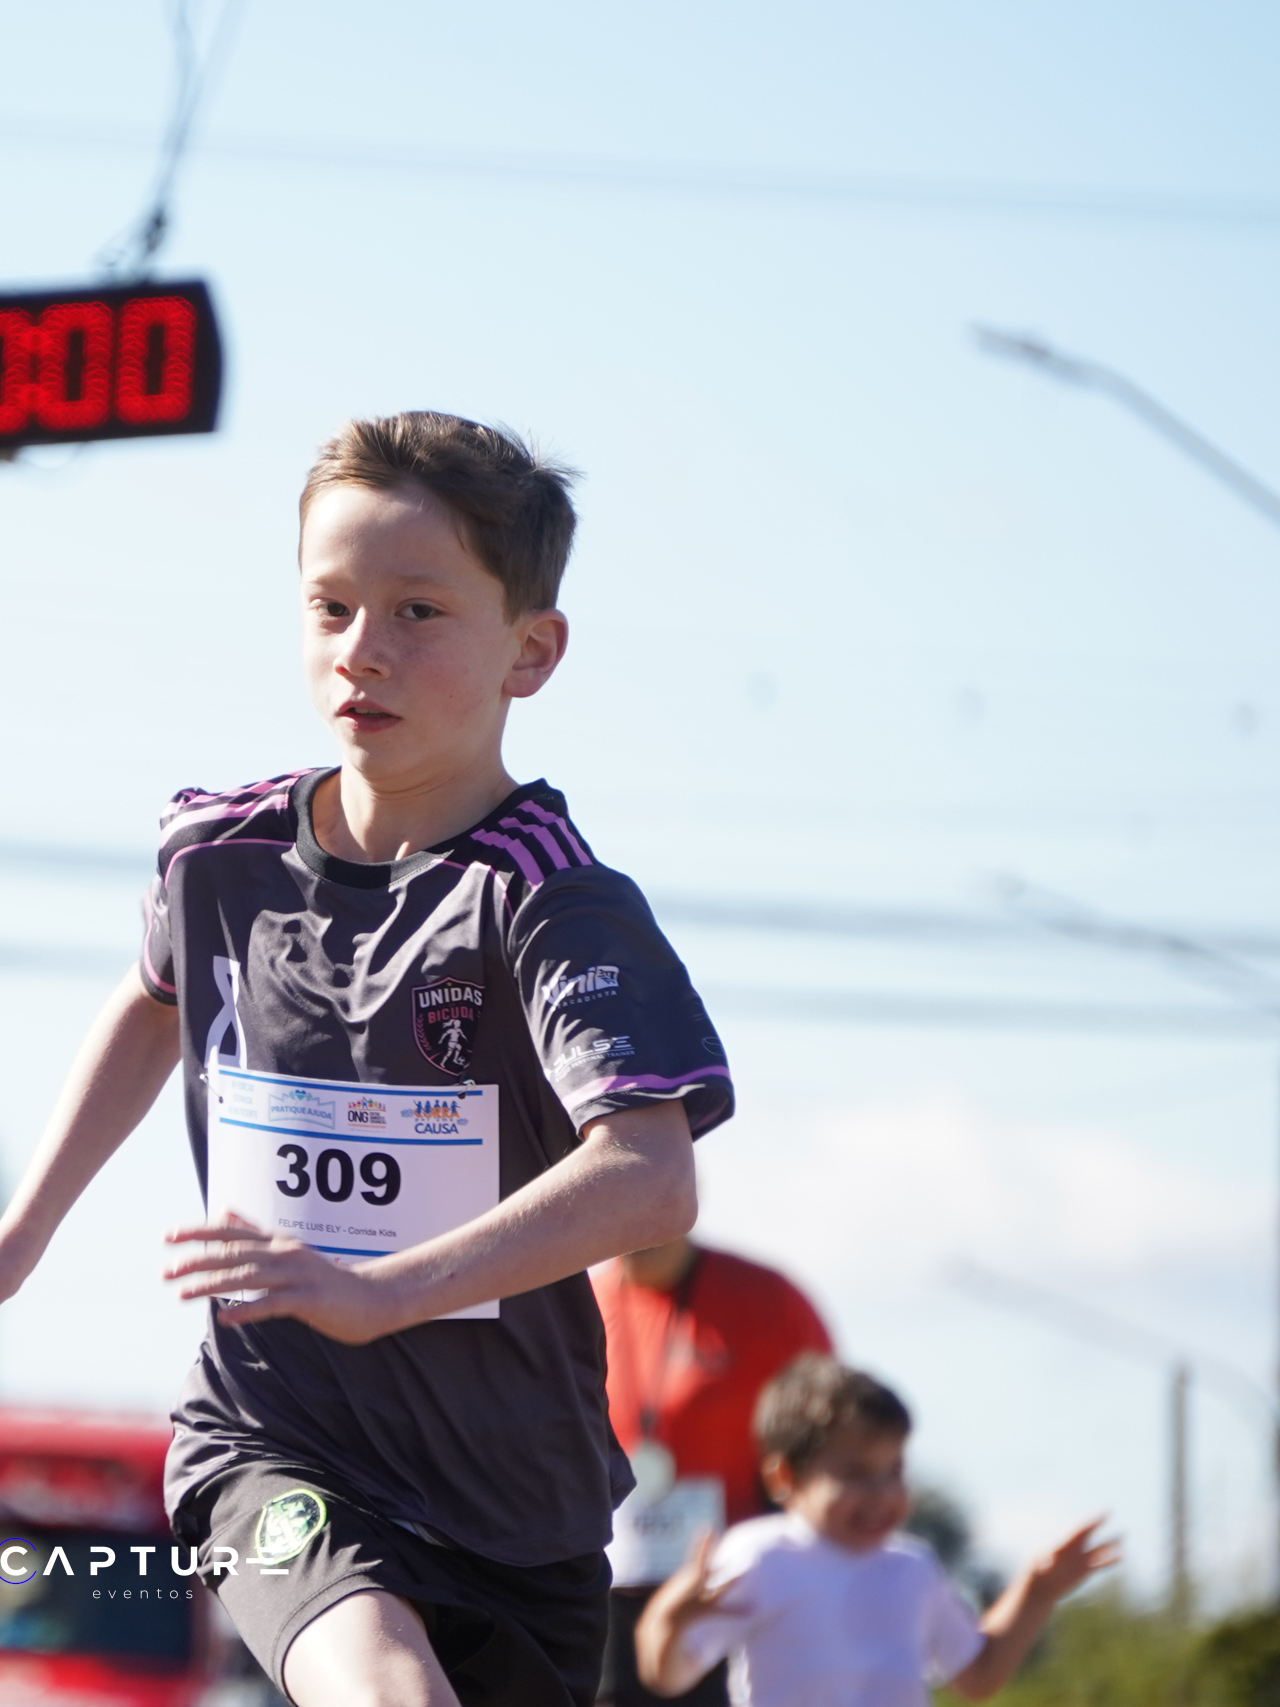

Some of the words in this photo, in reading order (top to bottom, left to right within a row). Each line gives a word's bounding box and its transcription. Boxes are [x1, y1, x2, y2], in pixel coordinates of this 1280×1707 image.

[418, 986, 483, 1008] UNIDAS
[428, 1006, 474, 1024] BICUDA
[607, 1050, 636, 1058] TRAINER
[271, 1105, 306, 1115] PRATIQUE
[307, 1107, 332, 1120] AJUDA
[347, 1110, 369, 1123] ONG
[414, 1122, 459, 1134] CAUSA
[275, 1144, 401, 1206] 309
[278, 1218, 305, 1230] FELIPE
[306, 1221, 325, 1232] LUIS
[326, 1224, 342, 1234] ELY
[348, 1225, 377, 1237] Corrida
[379, 1228, 397, 1238] Kids
